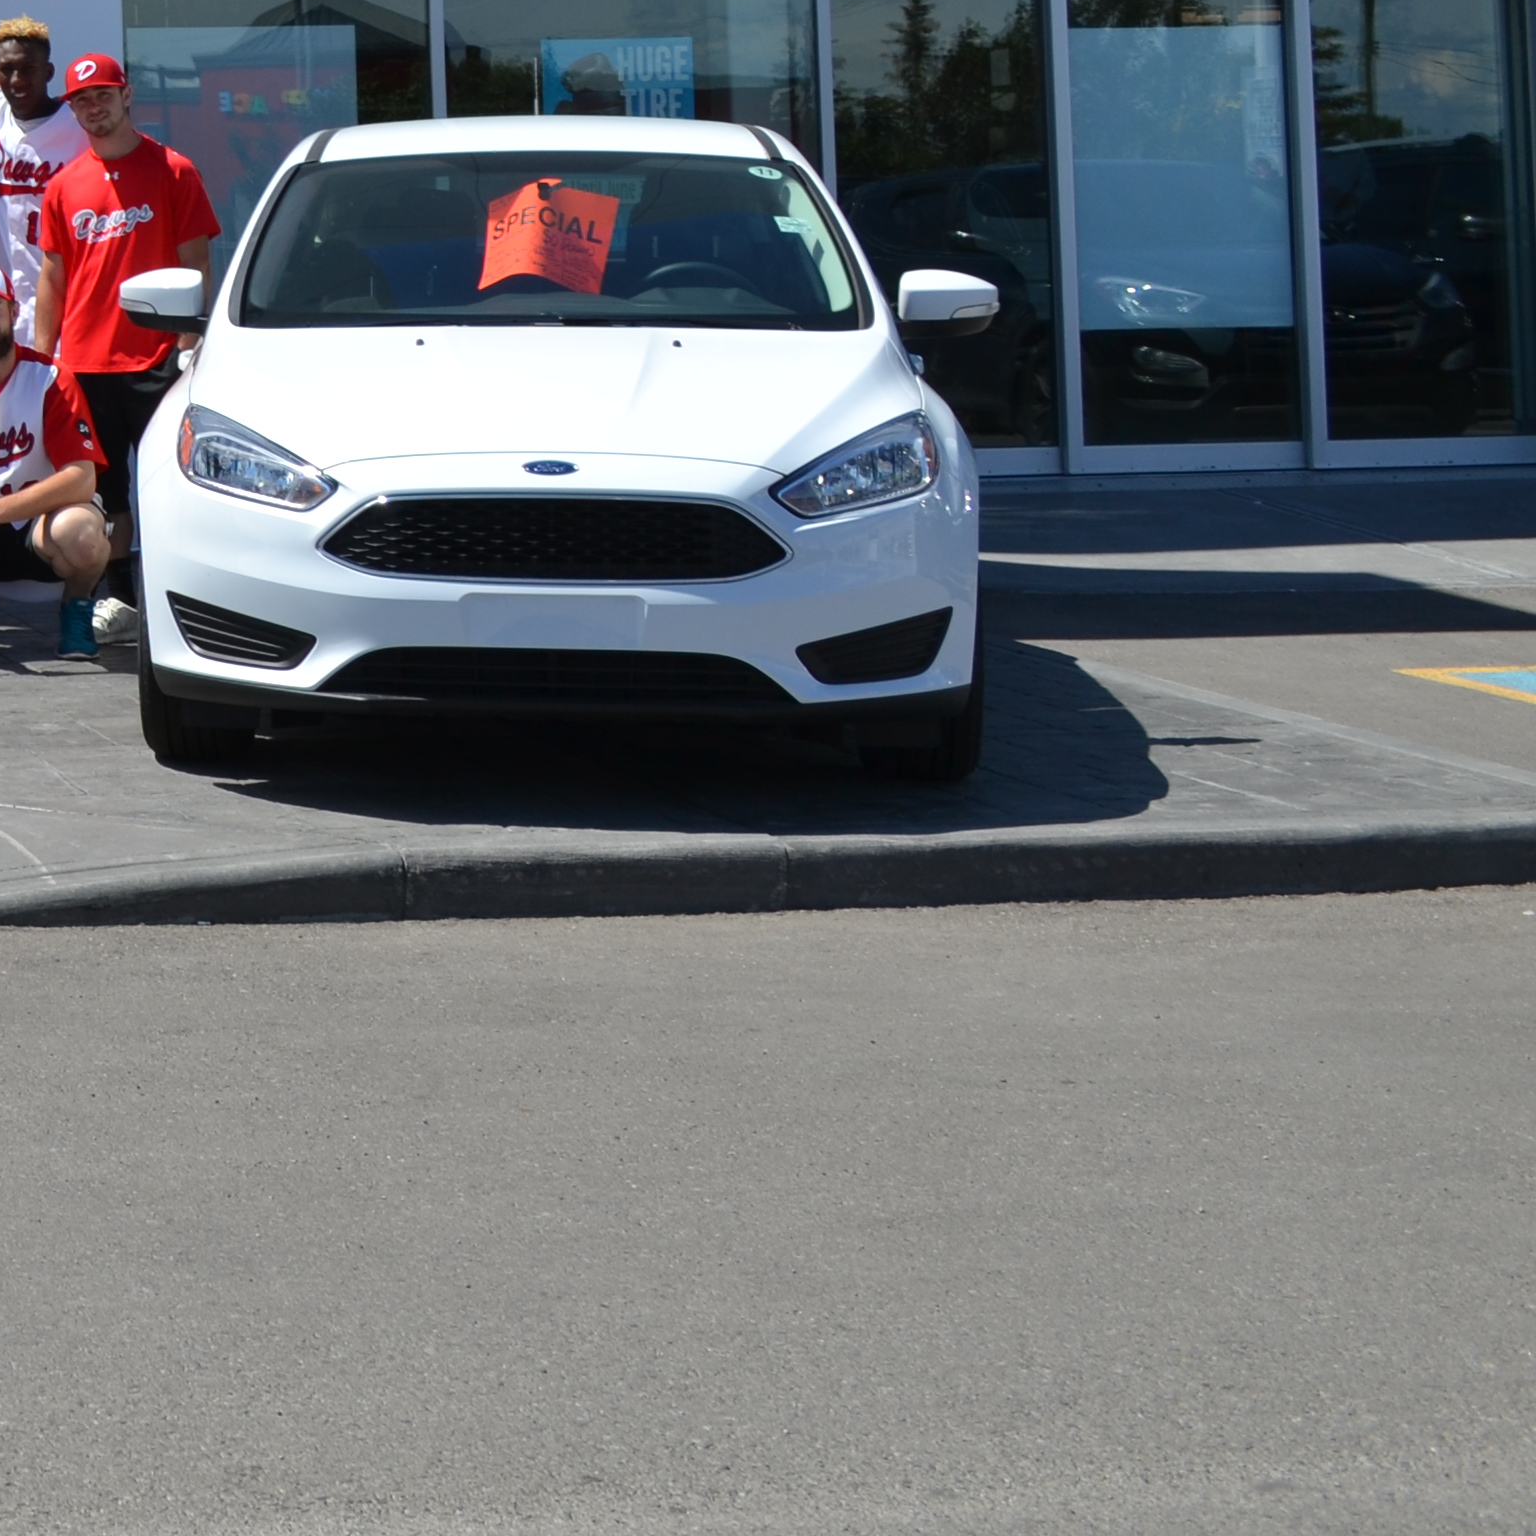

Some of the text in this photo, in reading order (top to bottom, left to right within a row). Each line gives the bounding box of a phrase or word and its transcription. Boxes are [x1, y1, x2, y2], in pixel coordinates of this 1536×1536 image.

[617, 45, 690, 82] HUGE
[72, 203, 154, 240] Dawgs
[493, 206, 603, 245] SPECIAL
